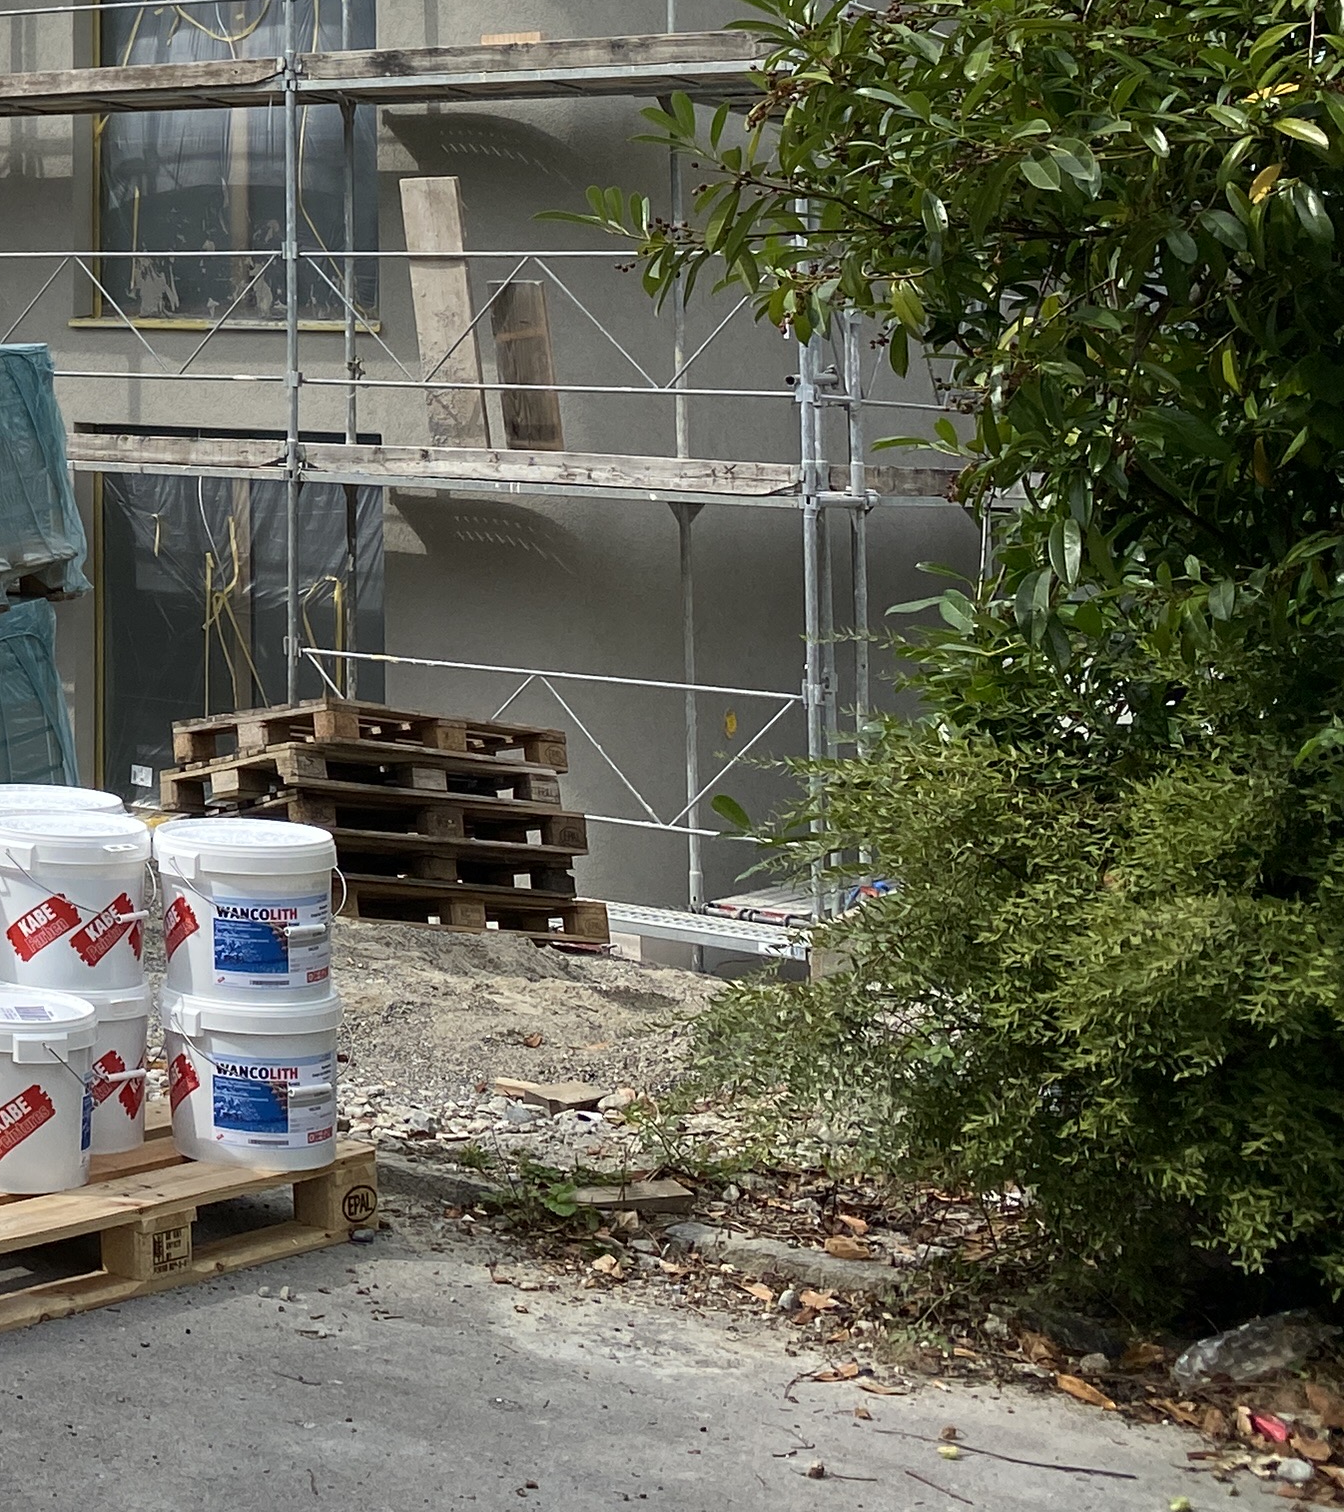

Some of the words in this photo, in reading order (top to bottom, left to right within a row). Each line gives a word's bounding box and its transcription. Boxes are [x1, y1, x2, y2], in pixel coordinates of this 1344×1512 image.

[17, 903, 57, 937] KABE
[84, 904, 120, 942] KABE
[216, 905, 297, 921] WANCOLITH
[215, 1063, 298, 1080] WANCOLITH
[348, 1192, 373, 1216] EPAL
